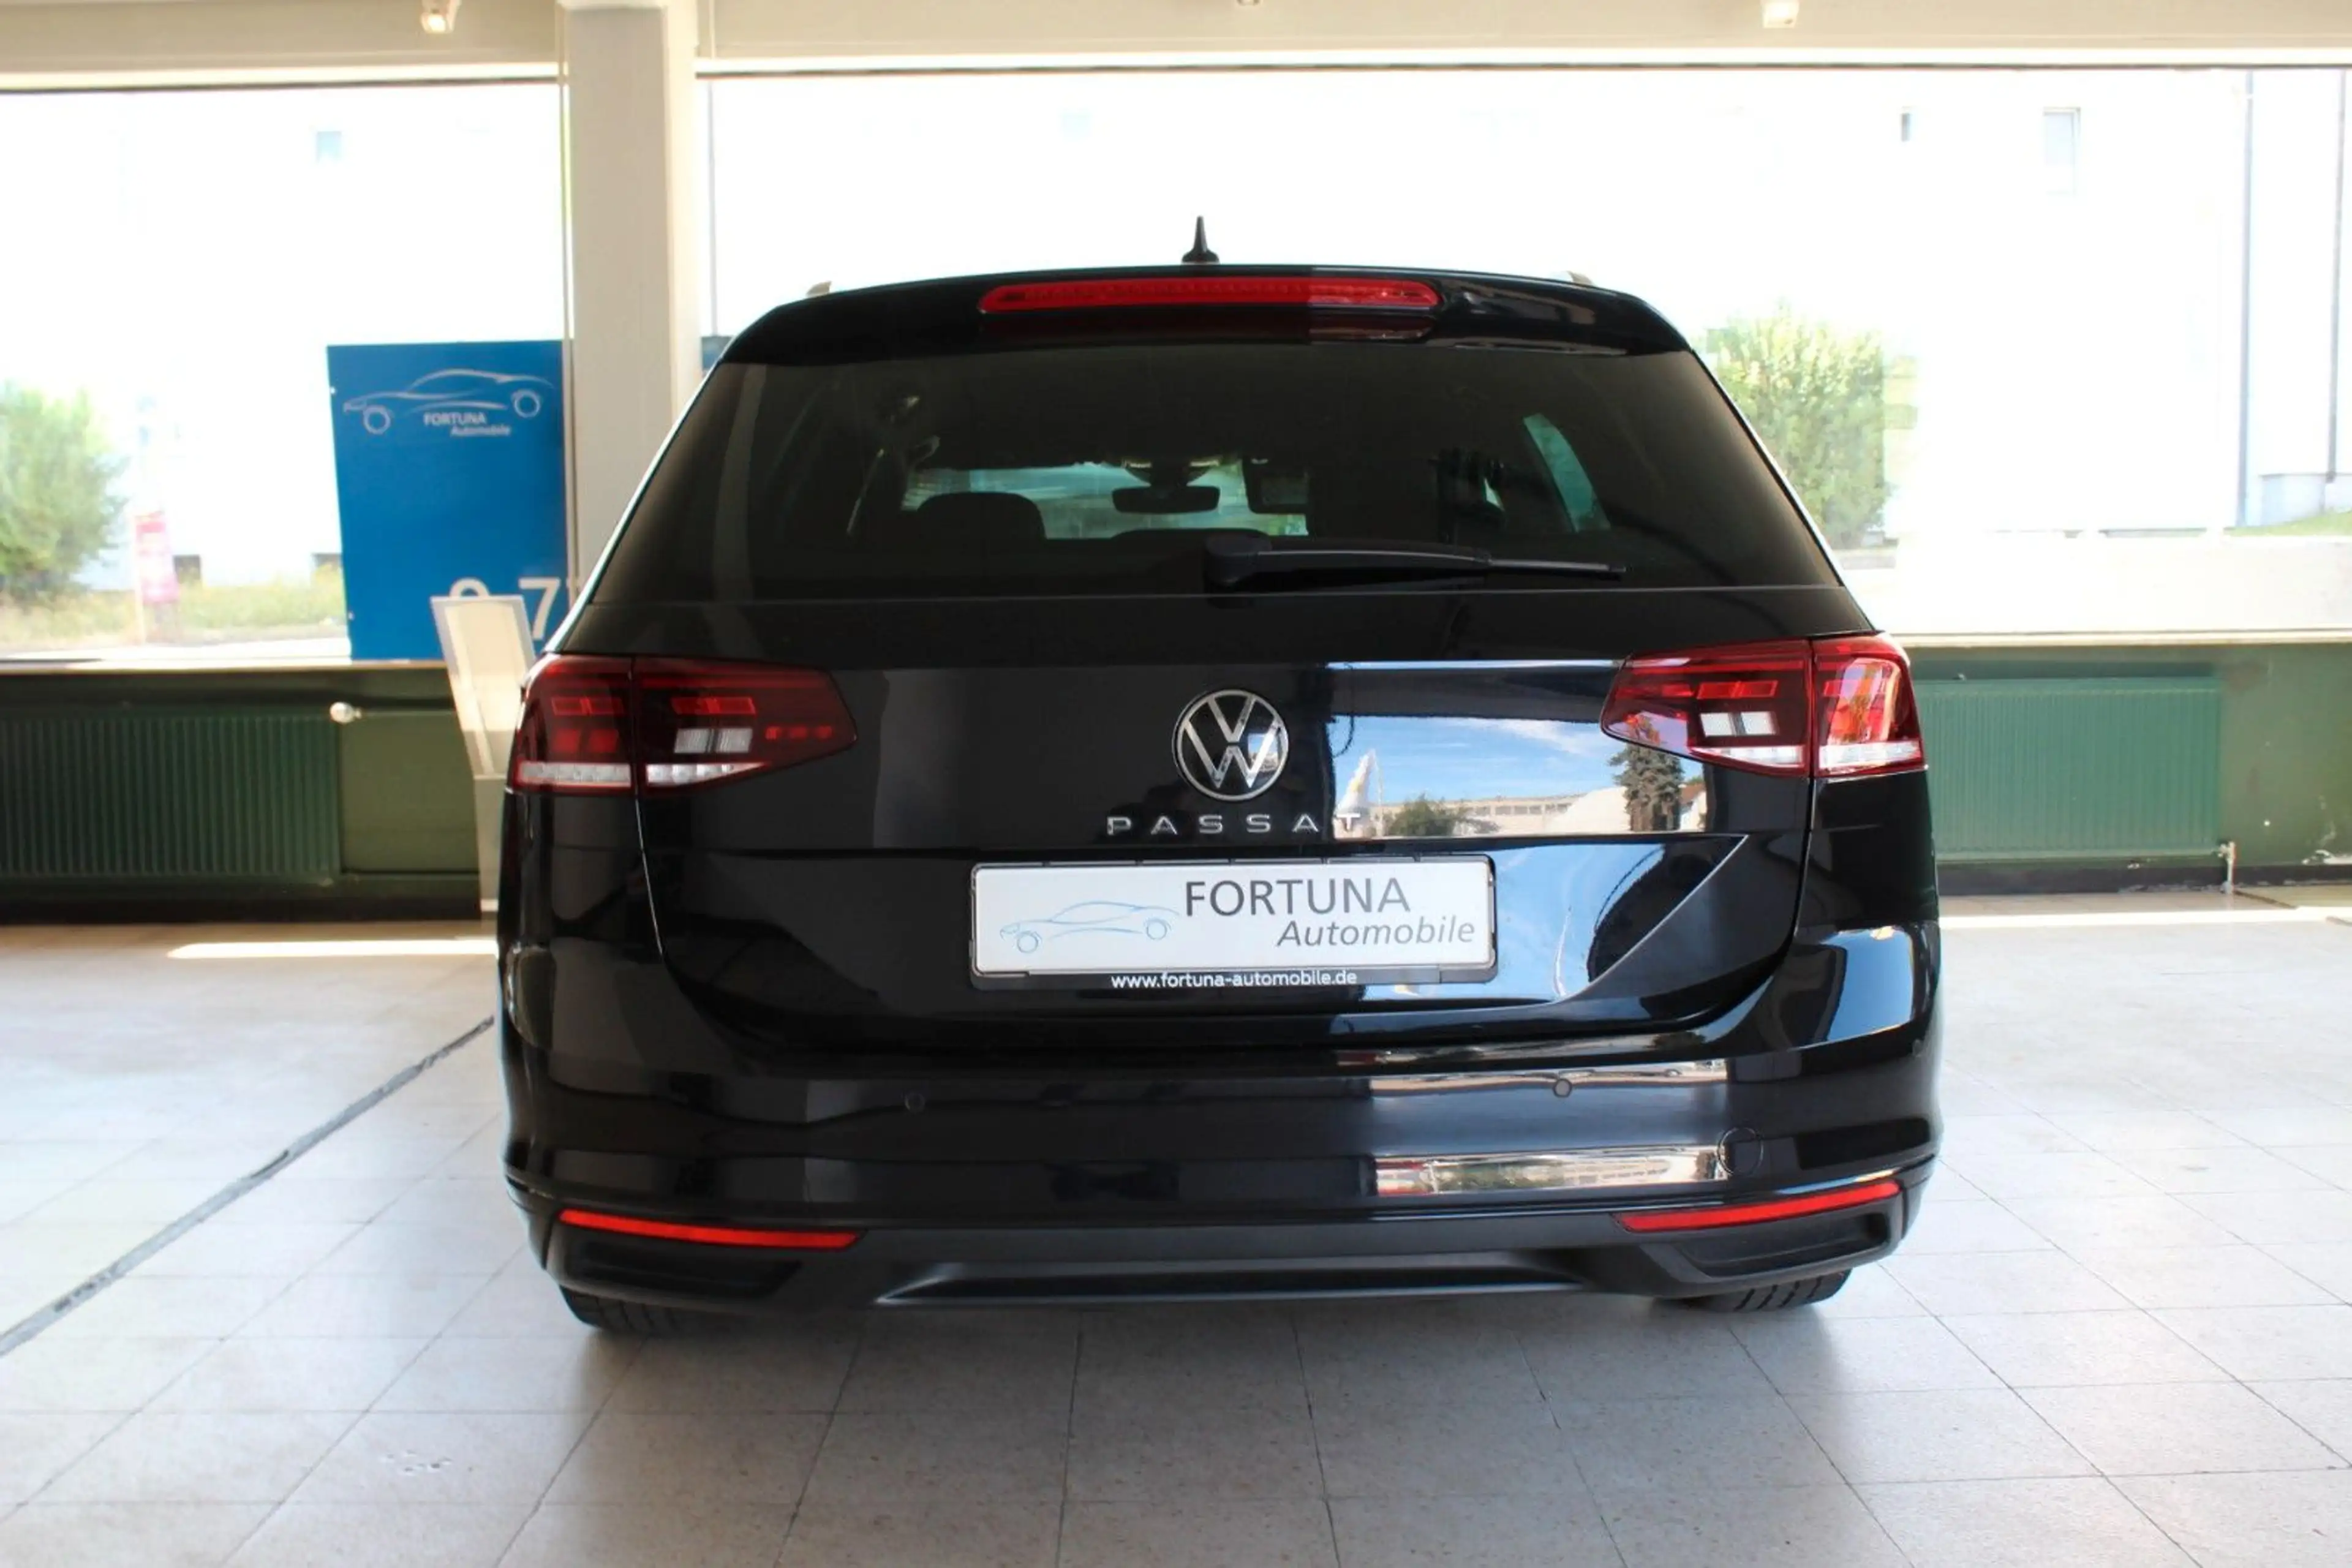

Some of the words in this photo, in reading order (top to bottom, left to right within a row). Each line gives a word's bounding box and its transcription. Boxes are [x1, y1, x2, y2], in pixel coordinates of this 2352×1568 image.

[423, 412, 487, 426] FORTUNA
[1174, 689, 1289, 800] VW
[1106, 813, 1360, 835] PASSAT
[1185, 878, 1411, 917] FORTUNA
[1276, 915, 1476, 947] Automobile
[1111, 970, 1358, 989] www.fortuna-automobile.de
